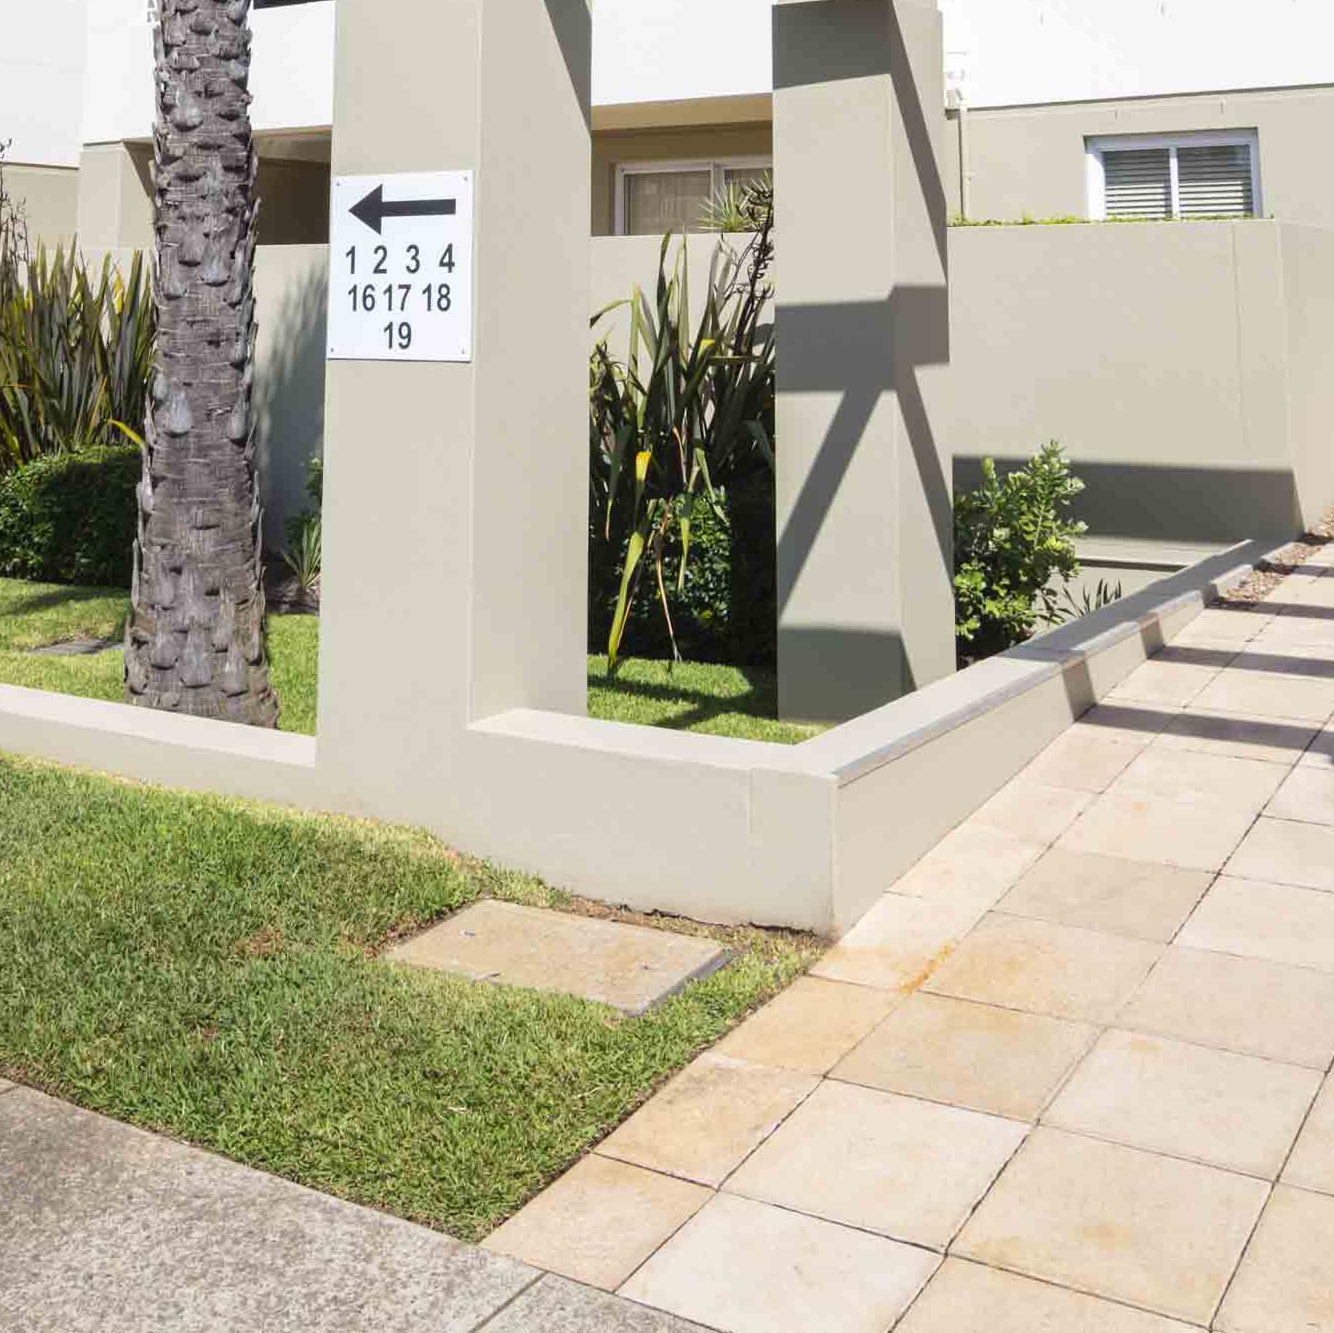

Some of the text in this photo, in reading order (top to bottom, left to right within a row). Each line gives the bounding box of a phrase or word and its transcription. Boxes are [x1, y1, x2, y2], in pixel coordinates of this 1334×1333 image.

[345, 242, 455, 275] 1 2 3 4
[347, 282, 452, 312] 16 17 18
[383, 321, 412, 350] 19
